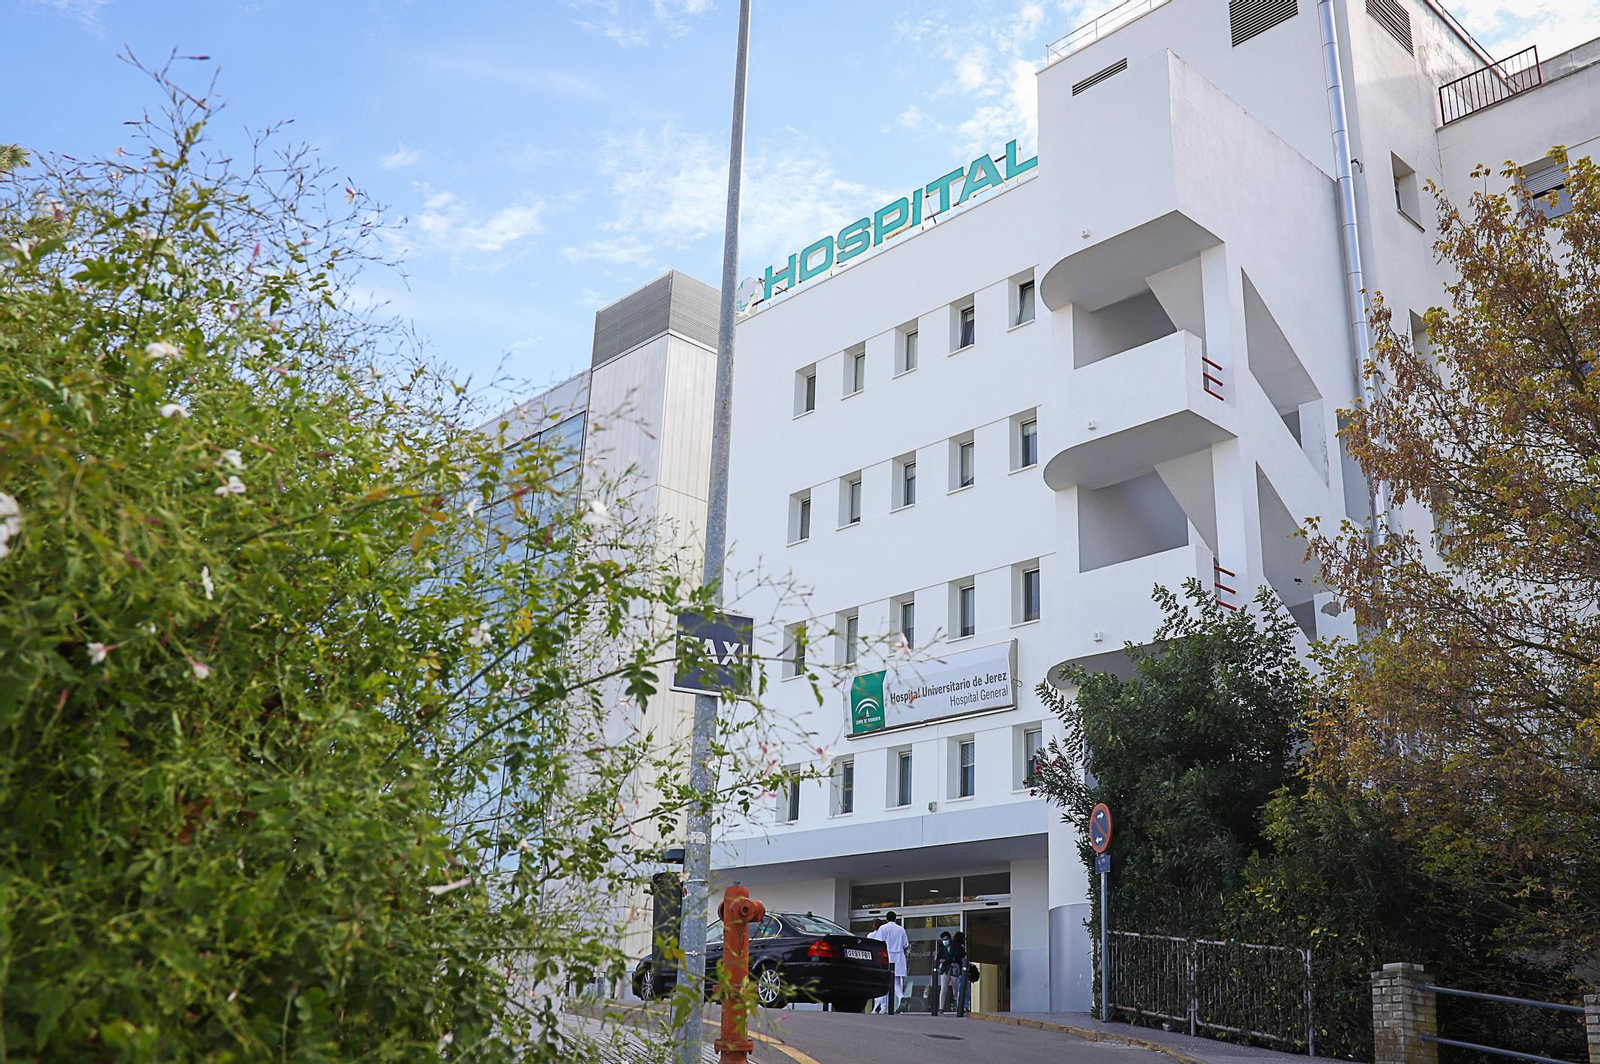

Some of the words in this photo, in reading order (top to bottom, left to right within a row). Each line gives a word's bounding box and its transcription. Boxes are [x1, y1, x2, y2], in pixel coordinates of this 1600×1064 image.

[764, 139, 1038, 300] HOSPITAL
[890, 688, 920, 705] Hospital
[922, 679, 971, 698] Universitario
[972, 676, 983, 687] de
[984, 672, 1007, 685] Jerez
[950, 691, 979, 707] Hospital
[980, 685, 1009, 701] General
